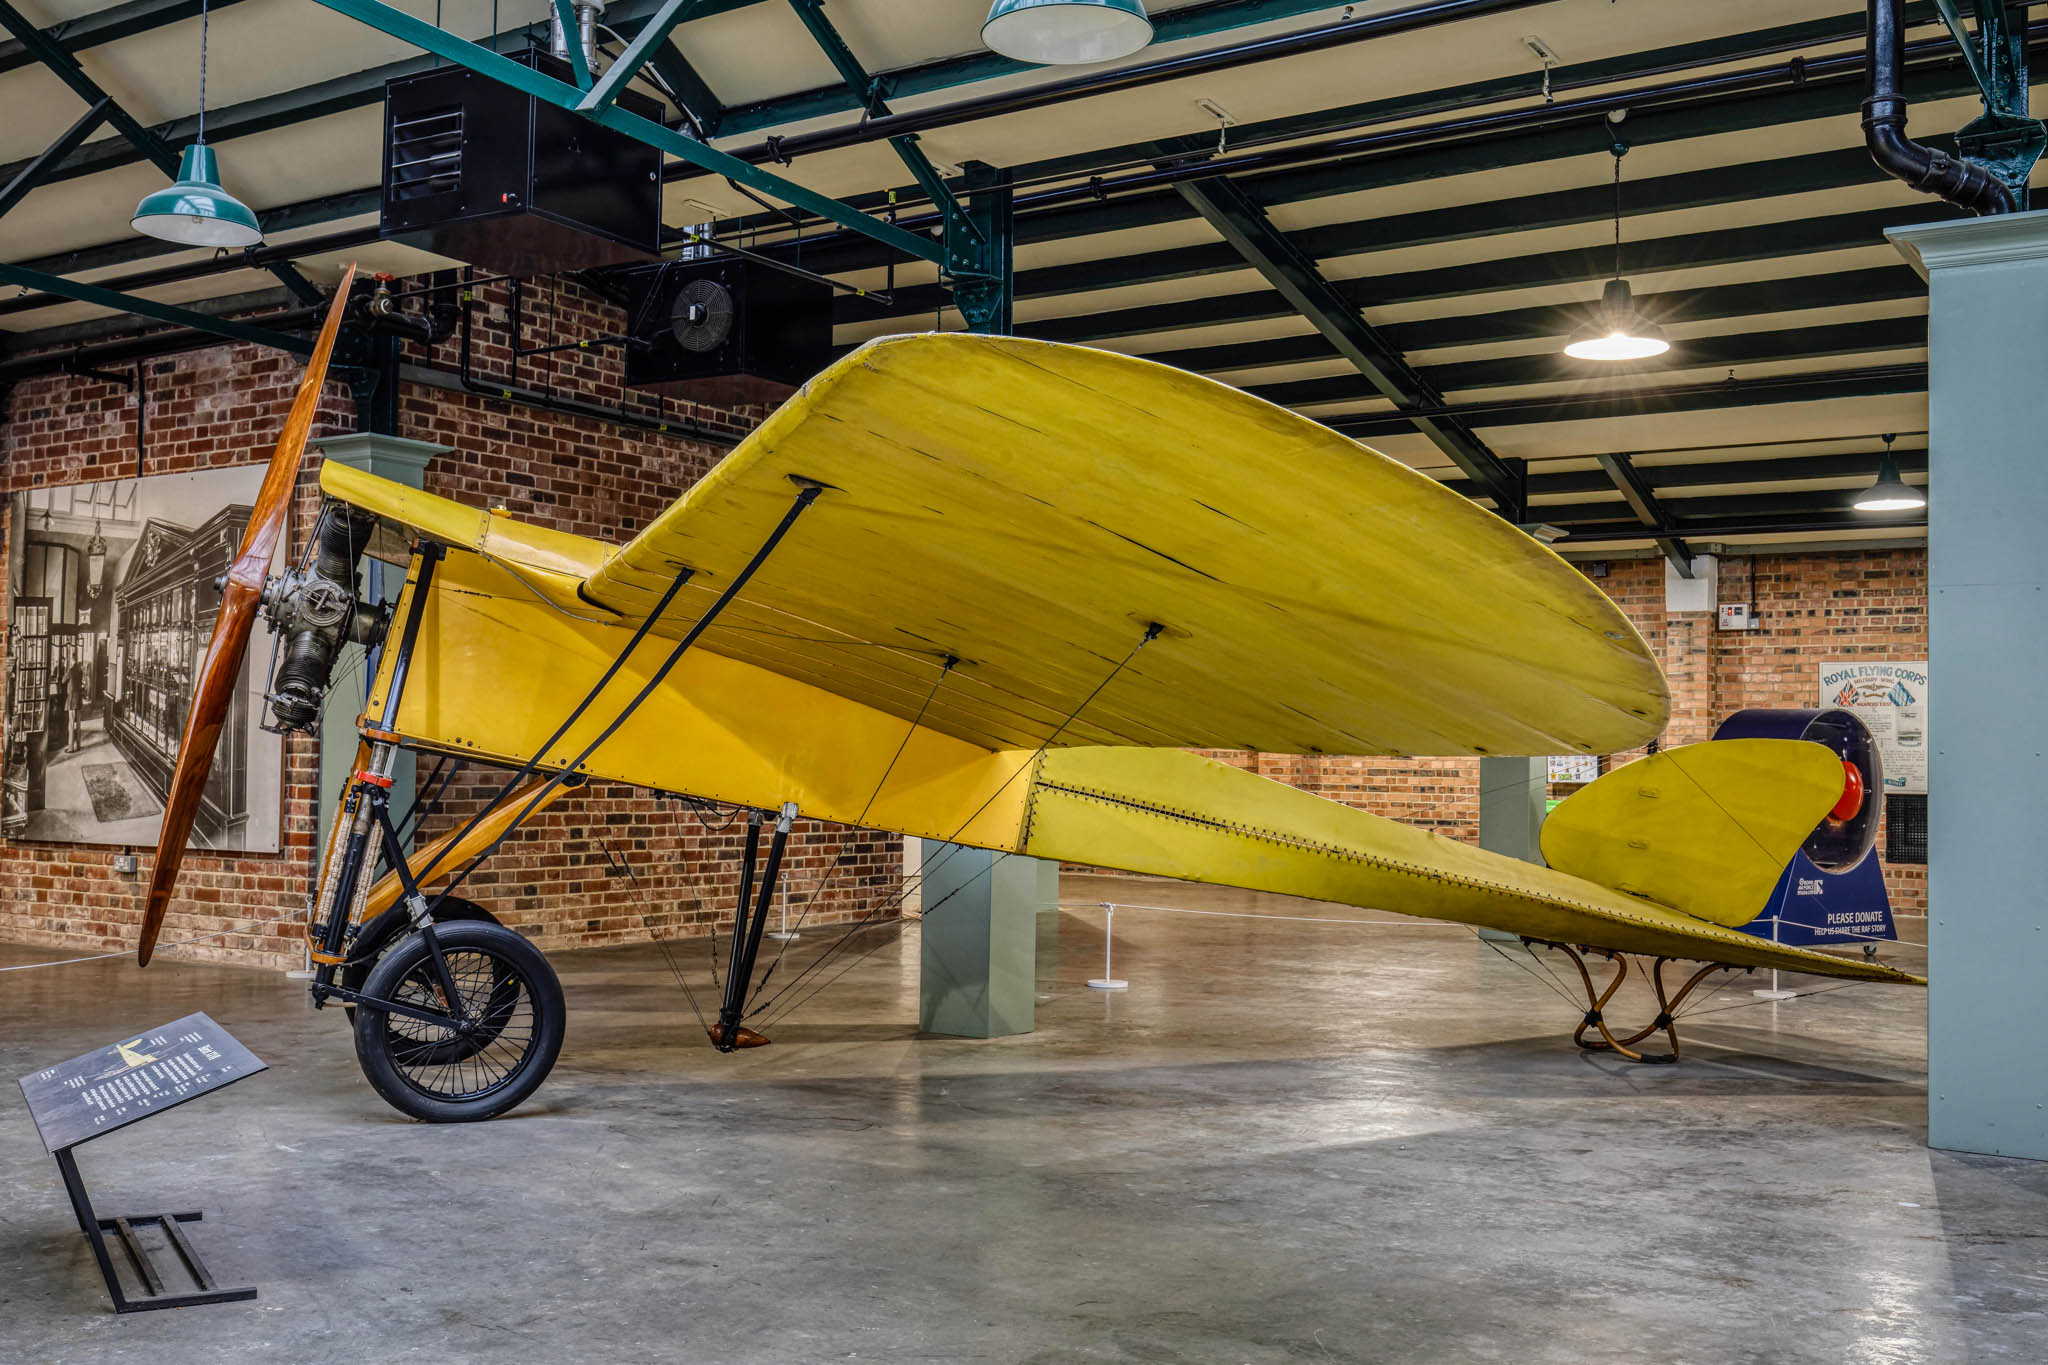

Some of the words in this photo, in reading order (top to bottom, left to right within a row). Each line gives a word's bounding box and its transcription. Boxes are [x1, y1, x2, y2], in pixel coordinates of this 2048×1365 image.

[1824, 668, 1857, 686] ROYAL
[1858, 665, 1893, 677] FLYING
[1894, 668, 1927, 686] CORPS
[1854, 677, 1878, 685] MILITARY
[1827, 912, 1854, 925] PLEASE
[1855, 911, 1883, 923] DONATE
[1814, 928, 1827, 936] HELP
[1827, 927, 1834, 935] US
[1835, 926, 1851, 935] SHARE
[1851, 926, 1861, 934] THE
[1861, 925, 1871, 933] RAF
[1871, 924, 1886, 932] STORY
